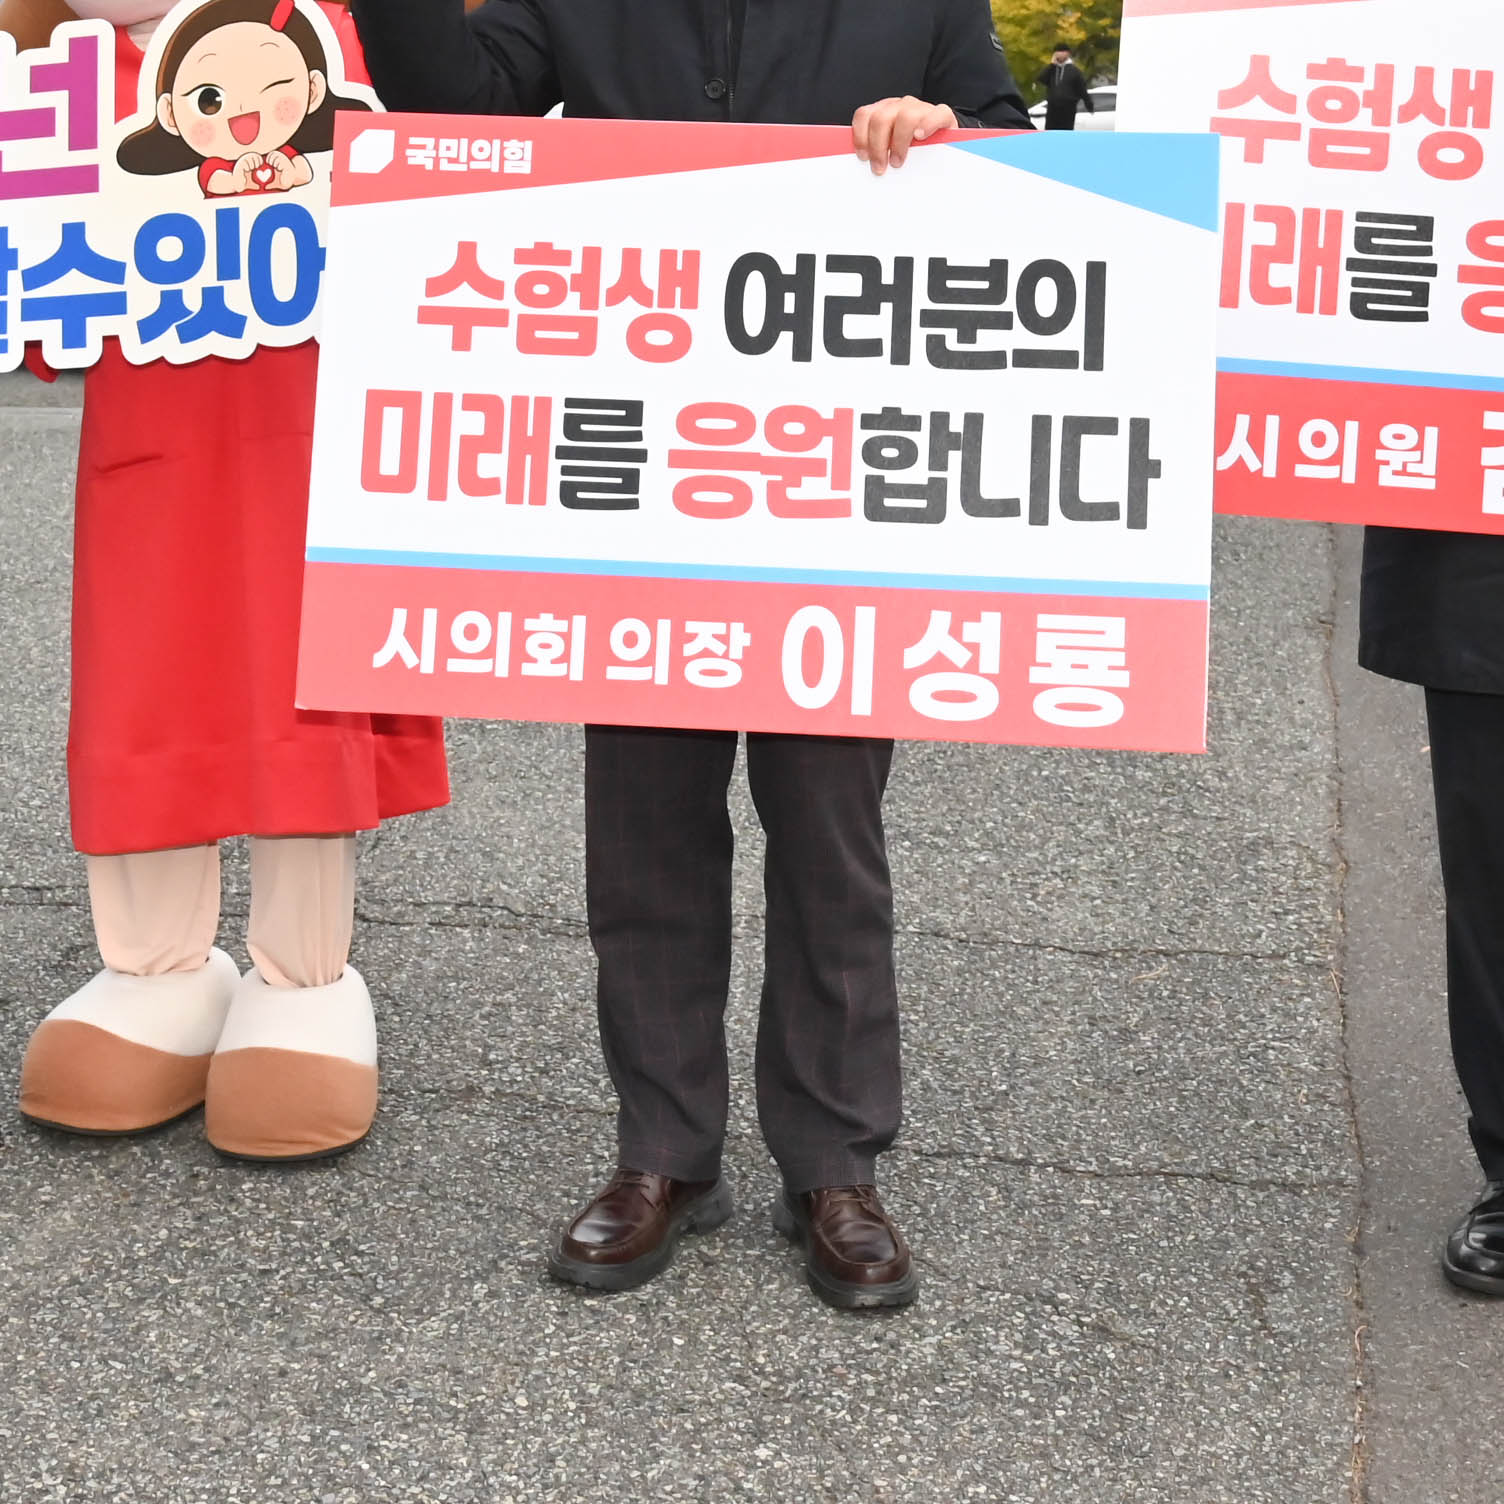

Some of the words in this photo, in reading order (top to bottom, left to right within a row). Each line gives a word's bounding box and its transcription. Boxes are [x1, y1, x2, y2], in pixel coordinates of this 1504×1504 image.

[406, 137, 532, 174] 국민의힘
[1211, 56, 1493, 180] 수험생
[418, 241, 700, 363] 수험생
[725, 252, 1106, 371] 여러분의
[362, 389, 647, 510] 미래를
[669, 402, 1161, 529] 응원합니다
[1218, 414, 1438, 489] 시의원
[373, 608, 586, 681] 시의회
[606, 618, 751, 688] 의장
[782, 605, 1130, 728] 이성룡
